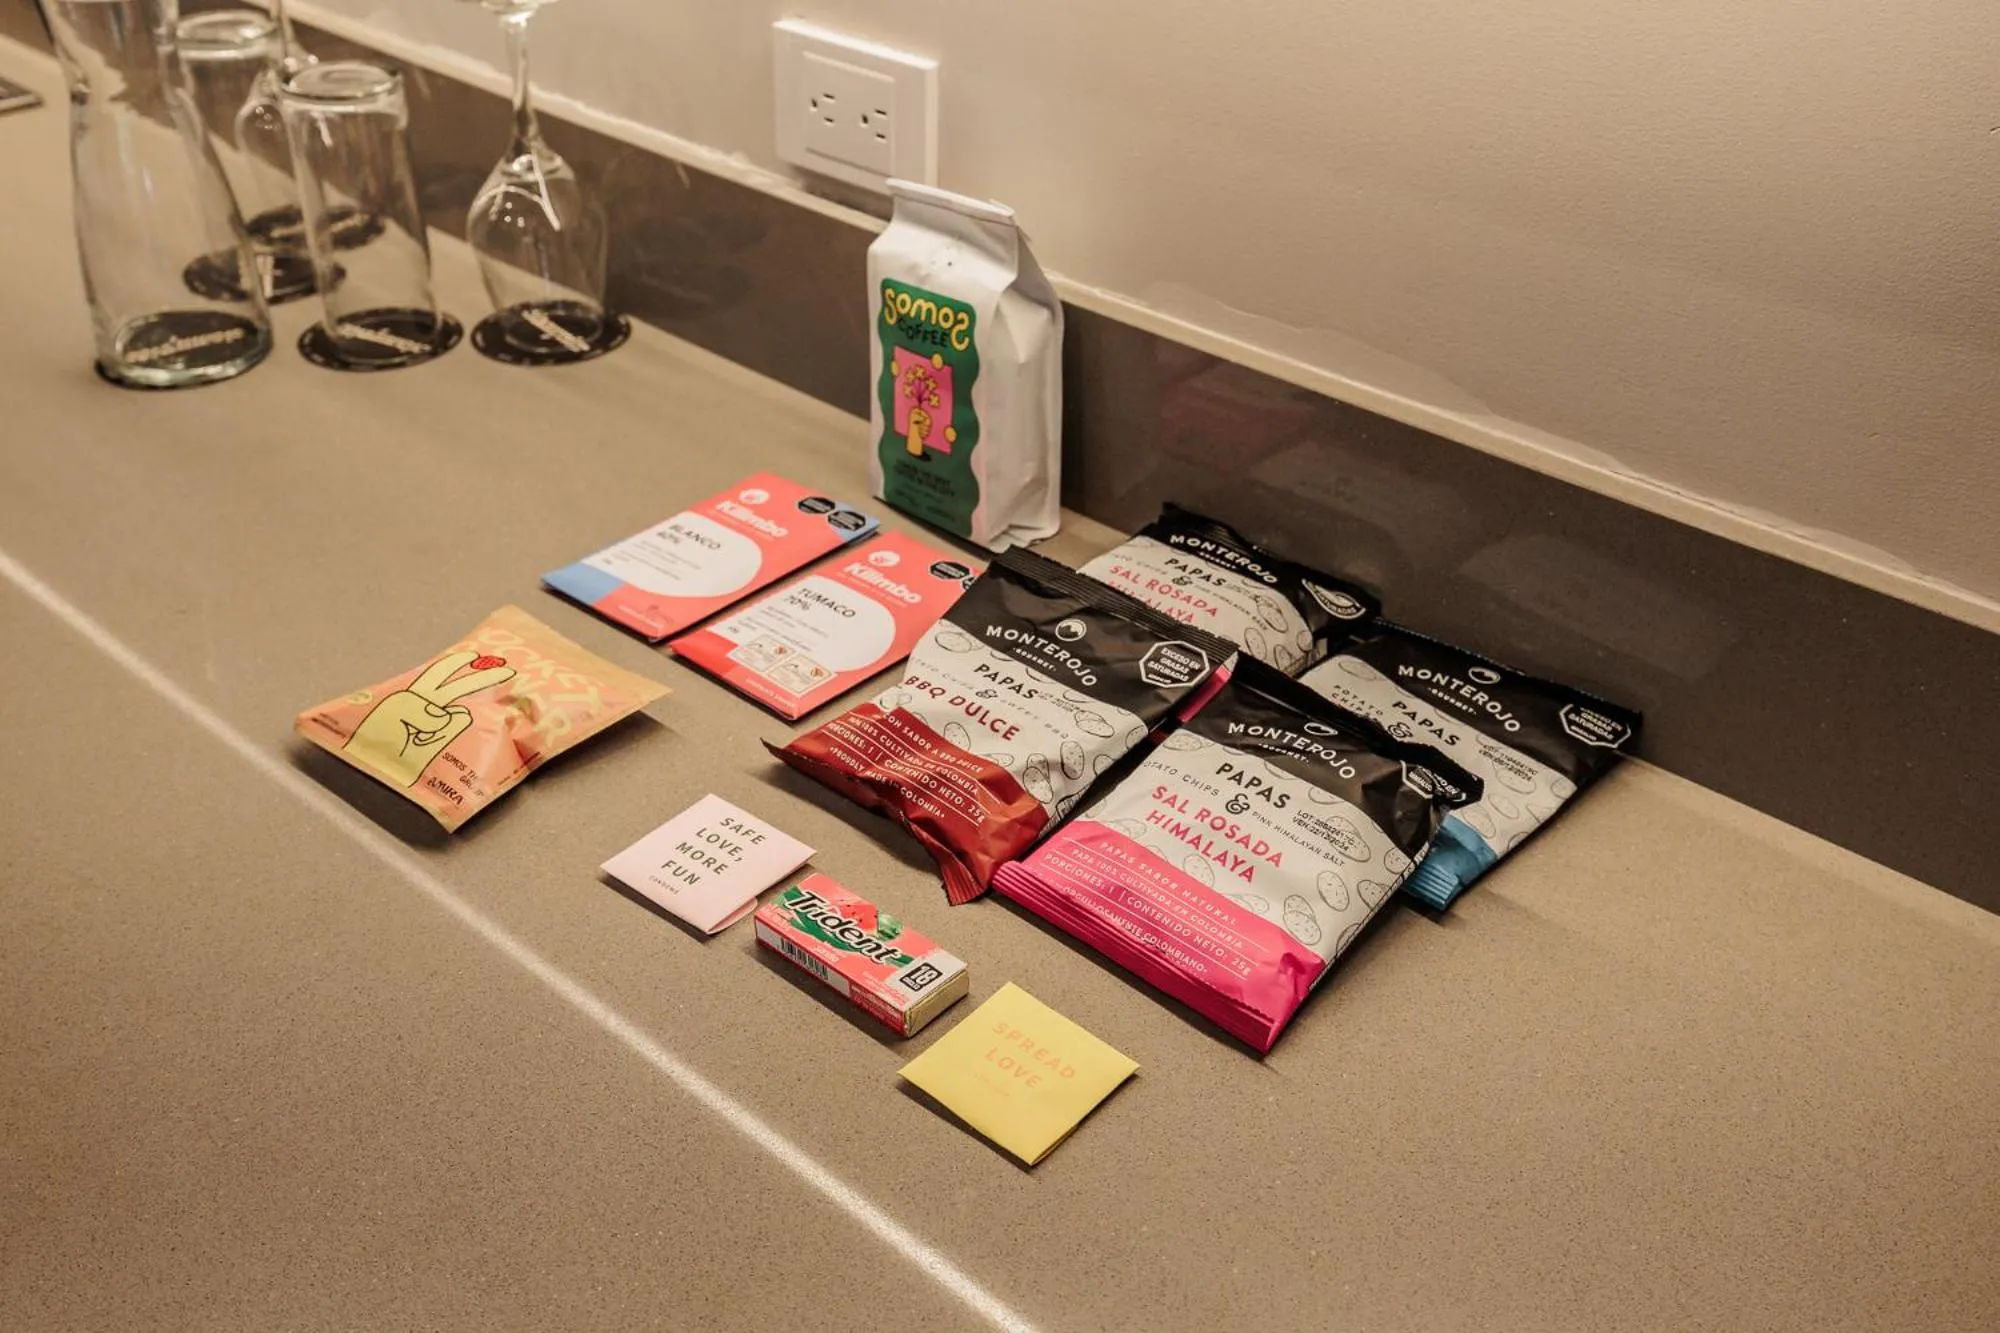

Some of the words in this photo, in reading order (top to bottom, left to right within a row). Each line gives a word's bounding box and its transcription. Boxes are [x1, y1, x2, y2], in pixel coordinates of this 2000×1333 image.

[1163, 557, 1227, 587] PAPAS
[1169, 534, 1278, 584] MONTEROJO
[798, 587, 857, 619] TUMACO
[1108, 563, 1141, 585] SAL
[1144, 578, 1218, 618] ROSADA
[985, 624, 1098, 687] MONTEROJO
[1160, 647, 1190, 665] EXCESO
[973, 662, 1039, 700] PAPAS
[1397, 664, 1521, 733] MONTEROJO
[904, 675, 947, 700] BBQ
[948, 695, 1021, 741] DULCE
[1391, 700, 1462, 747] PAPAS
[441, 751, 467, 772] SOMOS
[902, 726, 932, 751] SABOR
[1227, 721, 1357, 780] MONTEROJO
[879, 734, 923, 767] CULTIVADA
[935, 766, 980, 797] COLOMBIA
[883, 758, 938, 789] CONTENIDO
[1181, 774, 1220, 797] CHIPS
[1215, 761, 1292, 810] PAPAS
[427, 775, 464, 805] AMIRA
[1224, 792, 1251, 816] &
[694, 826, 746, 862] LOVE,
[718, 816, 768, 846] SAFE
[1145, 809, 1256, 884] HIMALAYA
[1151, 784, 1190, 815] SAL
[1194, 807, 1283, 869] ROSADA
[1252, 811, 1274, 828] PINK
[1273, 823, 1323, 855] HIMALAYAN
[1323, 852, 1346, 868] SALT
[659, 859, 701, 887] FUN
[674, 841, 729, 876] MORE
[1044, 852, 1105, 890] PORCIONES:
[1126, 895, 1192, 937] CONTENIDO
[1192, 934, 1228, 959] NETO:
[1100, 841, 1137, 864] PAPAS
[1138, 862, 1179, 890] SABOR
[1181, 888, 1237, 926] NATURAL
[786, 888, 904, 964] Trident
[1119, 872, 1173, 908] CULTIVADA
[1189, 913, 1243, 949] COLOMBIA
[909, 964, 940, 986] 18
[983, 1046, 1043, 1089] LOVE
[992, 1020, 1077, 1081] SPREAD
